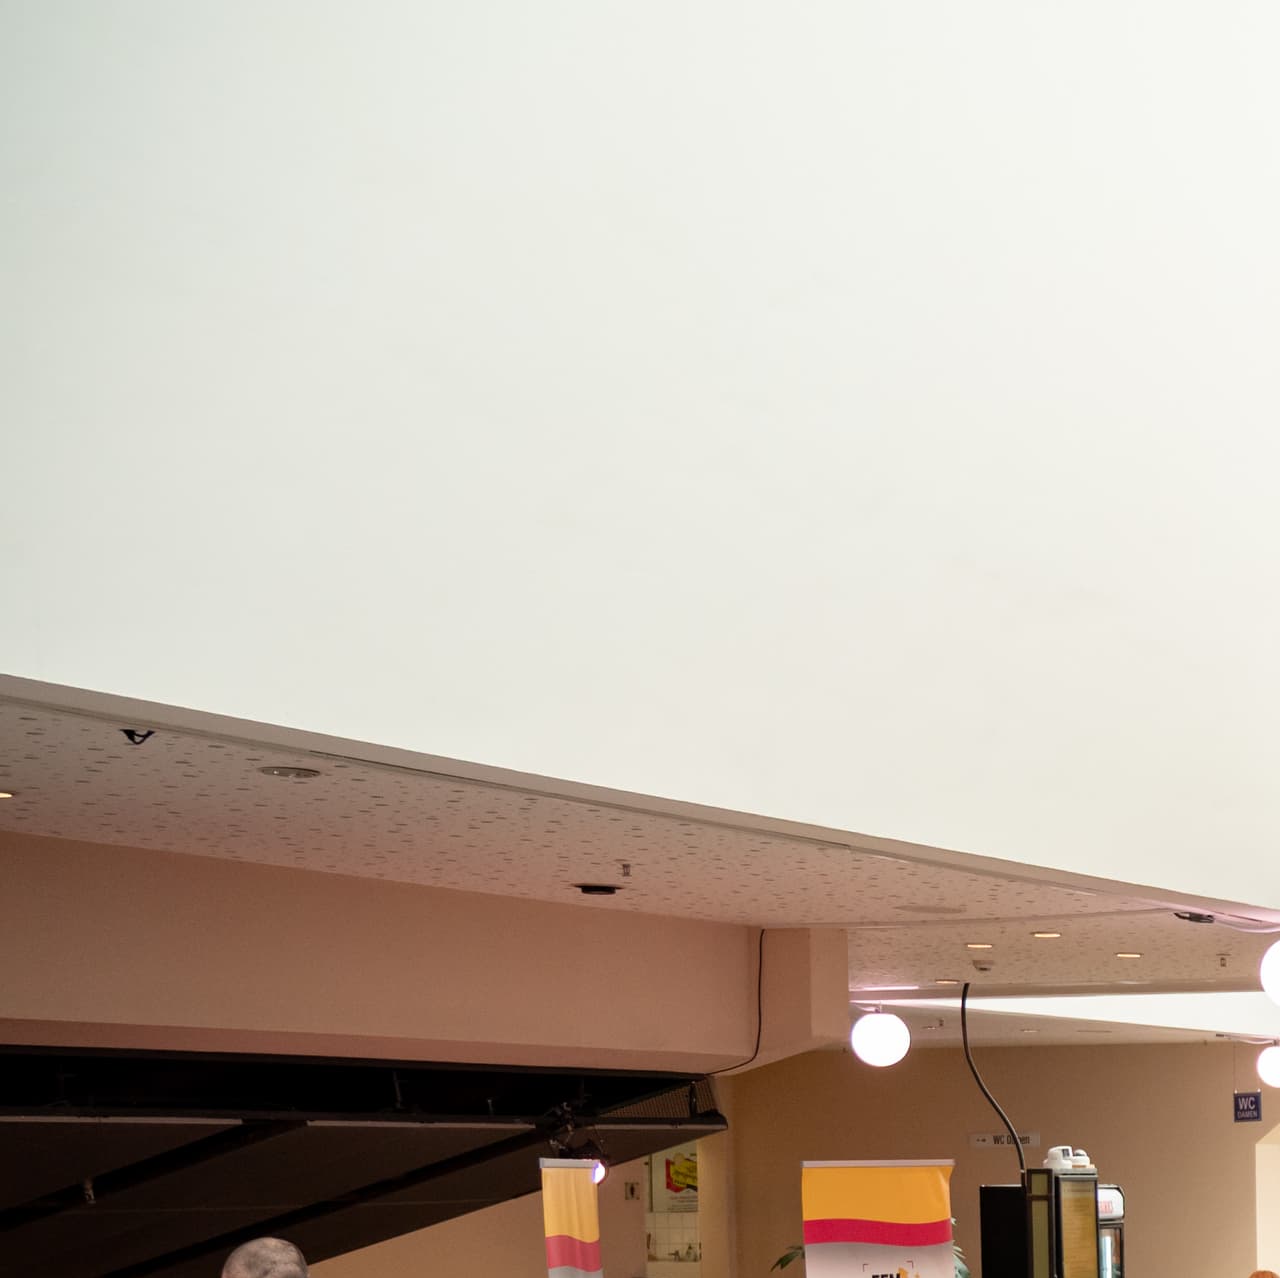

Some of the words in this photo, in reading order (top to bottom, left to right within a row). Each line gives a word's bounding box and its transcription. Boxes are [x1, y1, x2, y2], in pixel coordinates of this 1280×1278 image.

[1238, 1097, 1256, 1110] WC
[1237, 1111, 1258, 1119] DAMEN
[993, 1134, 1005, 1145] WC
